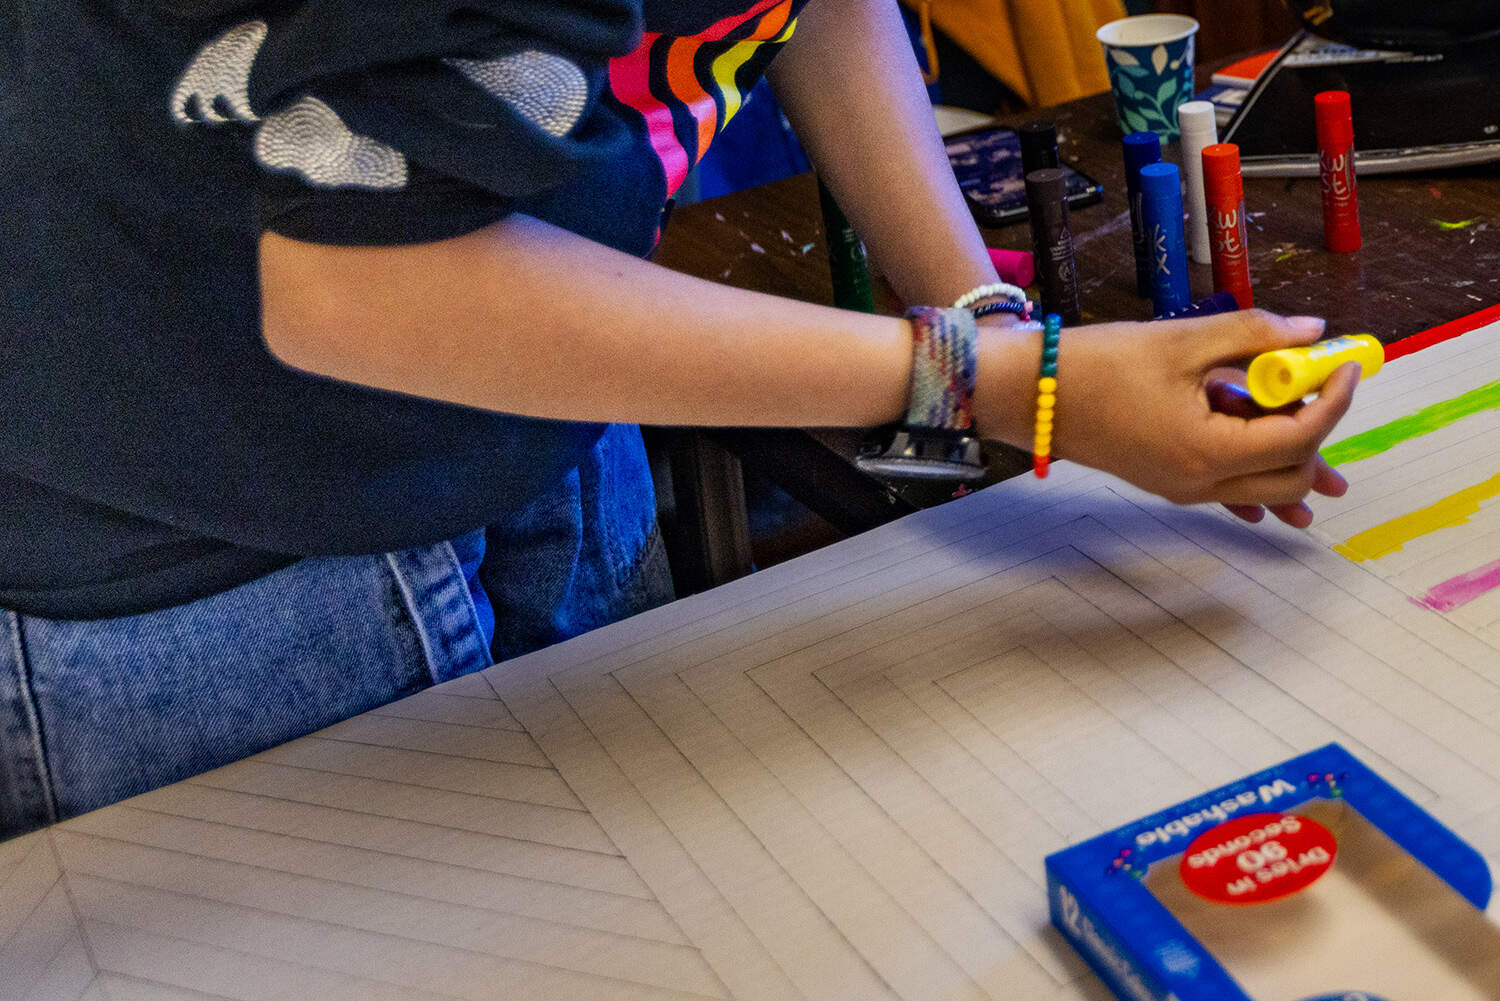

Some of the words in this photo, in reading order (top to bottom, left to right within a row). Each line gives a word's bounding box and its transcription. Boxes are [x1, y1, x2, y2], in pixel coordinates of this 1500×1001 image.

[1136, 779, 1297, 845] Washable
[1187, 815, 1302, 869] Seconds
[1236, 840, 1288, 873] 90
[1256, 846, 1331, 883] Dries
[1226, 876, 1257, 896] in
